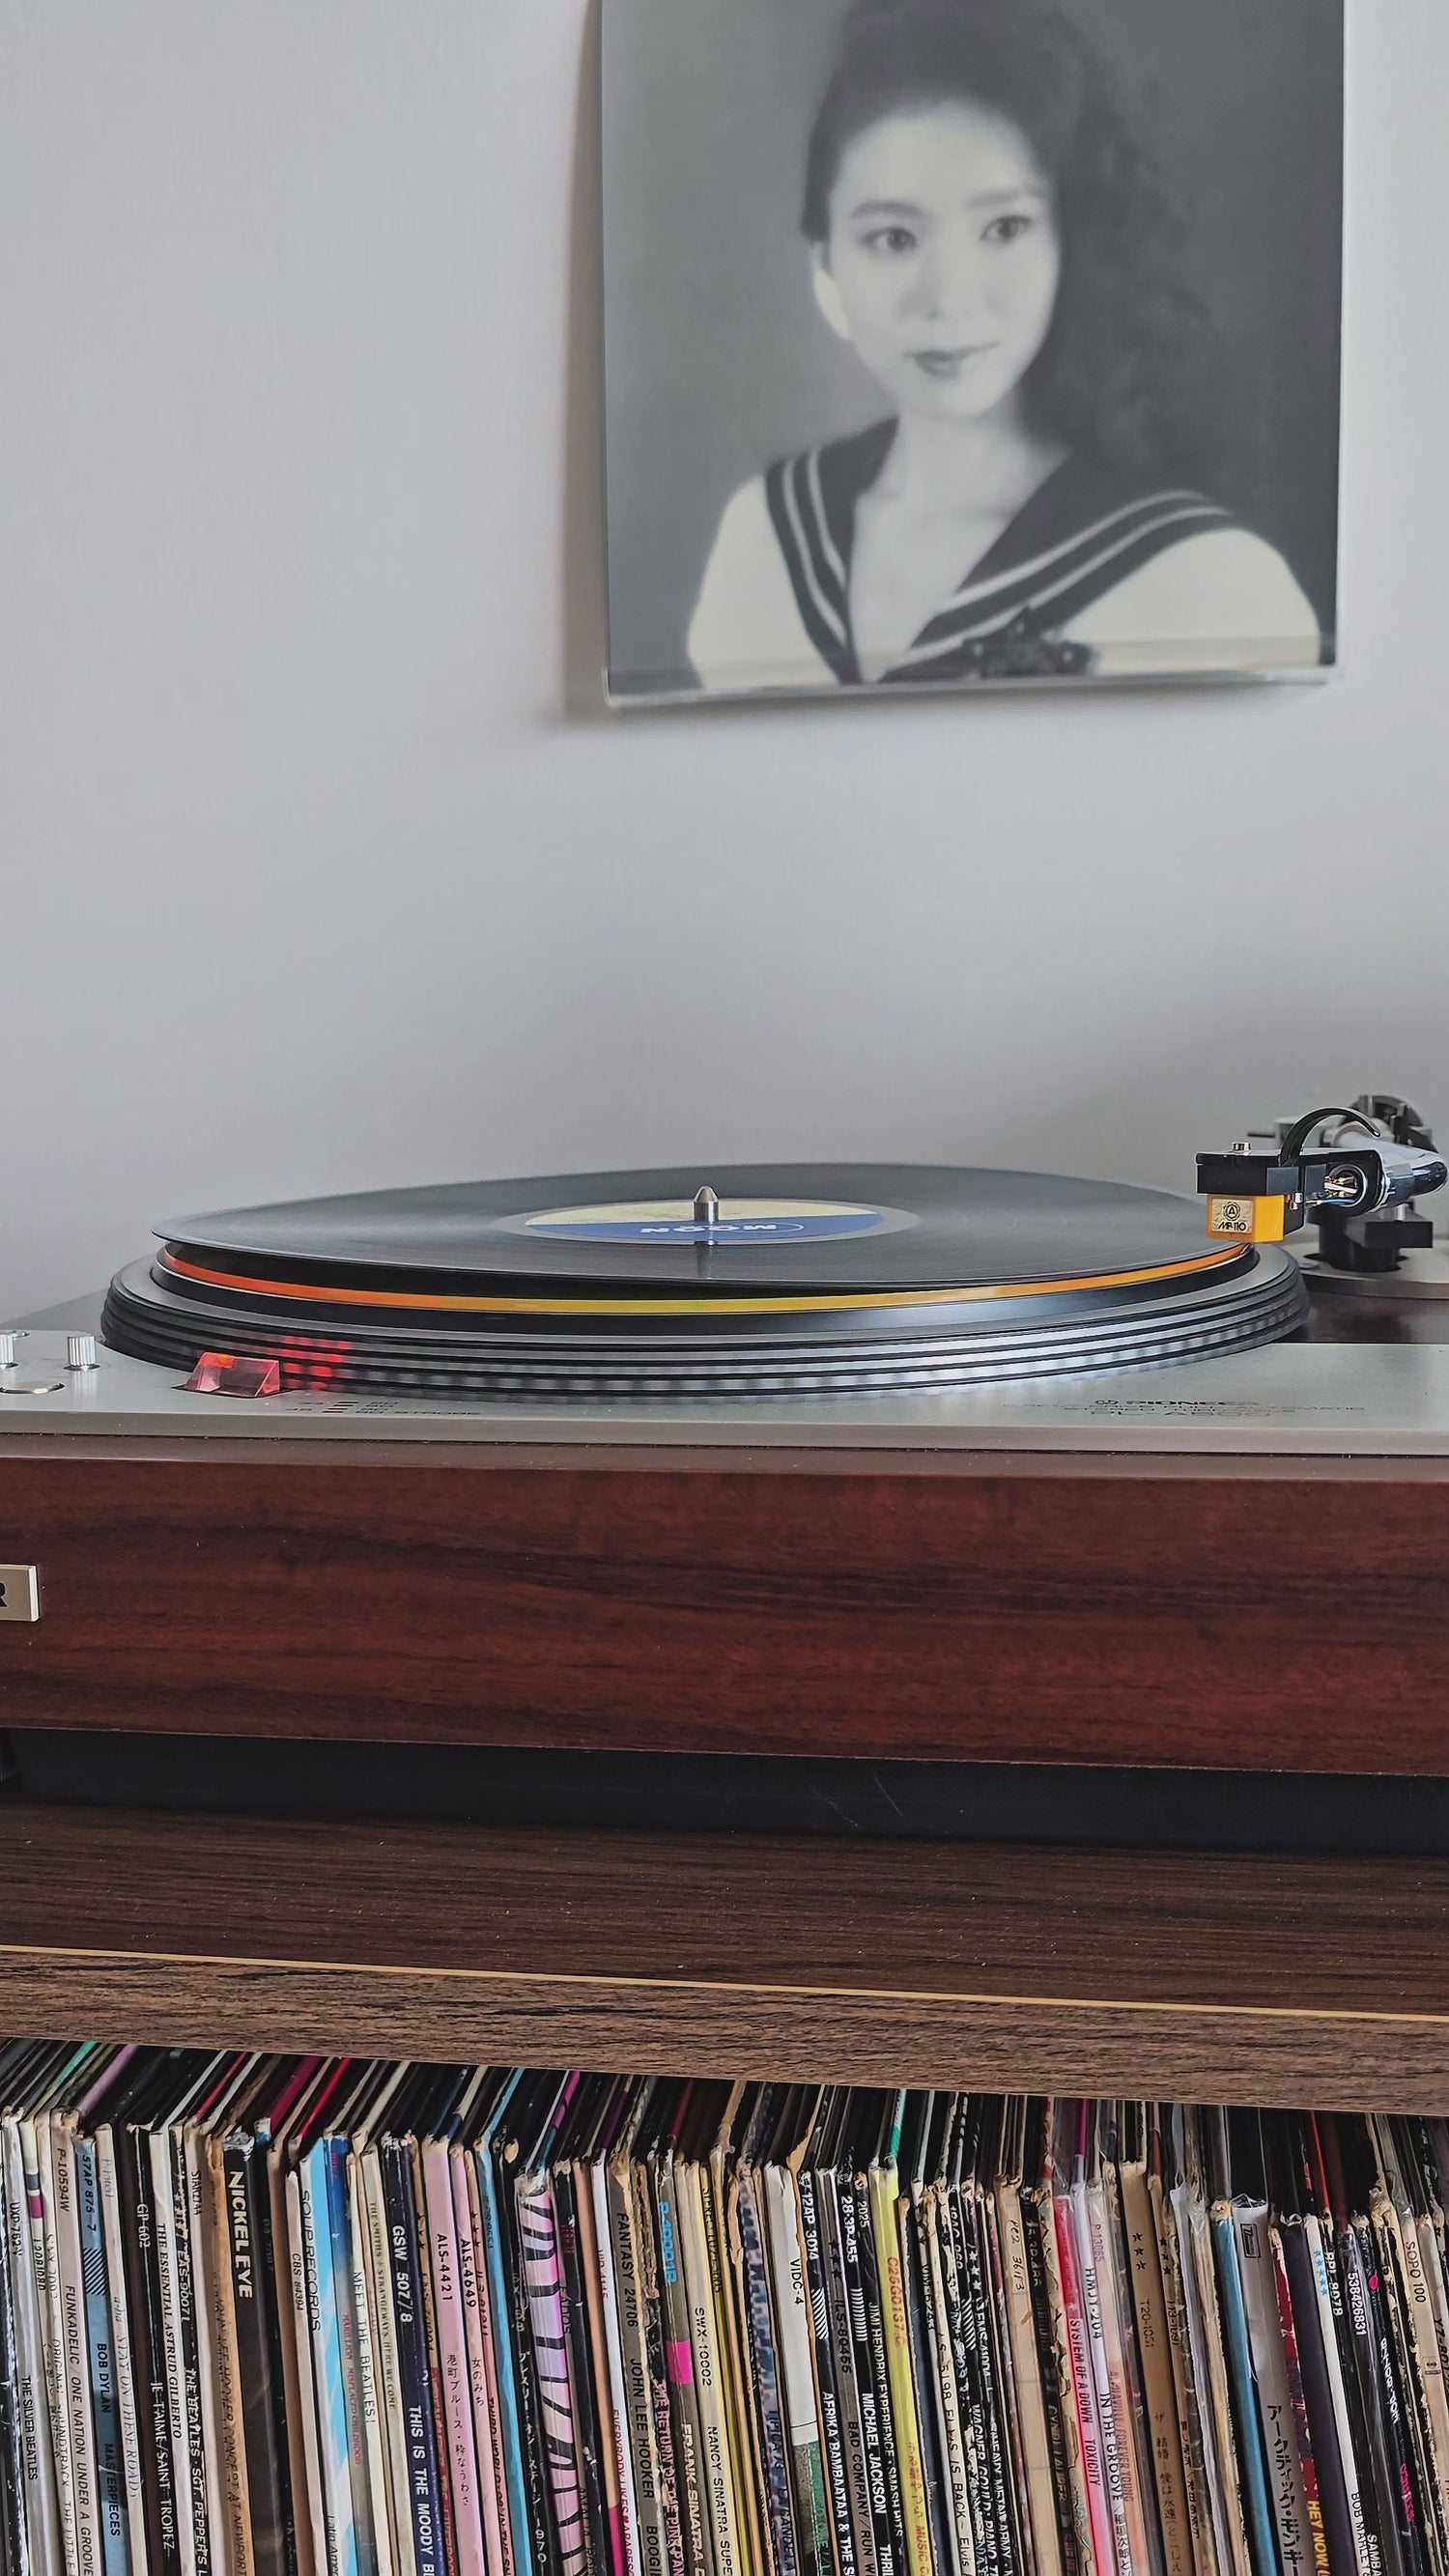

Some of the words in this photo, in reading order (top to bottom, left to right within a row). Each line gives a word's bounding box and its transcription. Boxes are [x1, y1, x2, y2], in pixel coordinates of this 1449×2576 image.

[57, 2148, 70, 2212] P-10594W
[157, 2223, 167, 2248] THE
[302, 2191, 314, 2240] SOUP
[857, 2201, 869, 2228] 2025
[372, 2222, 382, 2256] SMITHS
[392, 2225, 408, 2260] GSW
[805, 2230, 818, 2260] 3014
[159, 2252, 172, 2319] ESSENTIAL
[292, 2253, 301, 2275] CBS
[437, 2233, 453, 2301] ALS-4421
[461, 2239, 476, 2307] ALS-4649
[616, 2213, 634, 2280] FANTASY
[625, 2288, 639, 2327] 24706
[789, 2258, 805, 2305] VIDC-4
[1406, 2241, 1421, 2278] SOPO
[1414, 2282, 1427, 2303] 100
[304, 2246, 321, 2331] RECORDS
[1347, 2272, 1366, 2335] 538426831
[66, 2285, 80, 2364] FUNKADELIC
[868, 2302, 879, 2326] JIMI
[98, 2343, 108, 2368] BOB
[164, 2322, 177, 2372] ASTRUD
[695, 2307, 712, 2387] SWX-10002
[872, 2328, 886, 2381] HENDRIX
[1068, 2319, 1086, 2363] SYSTEM
[21, 2375, 32, 2396] THE
[71, 2377, 83, 2402] ONE
[99, 2373, 111, 2412] DYLAN
[185, 2368, 196, 2393] THE
[630, 2359, 644, 2397] JOHN
[1076, 2366, 1087, 2380] OF
[22, 2399, 34, 2432] SILVER
[169, 2377, 182, 2439] GILBERTO
[409, 2405, 425, 2437] THIS
[635, 2405, 648, 2430] LEE
[821, 2392, 835, 2437] AFRIKA
[861, 2392, 879, 2449] MICHAEL
[878, 2384, 894, 2456] EXPERIENCE
[1080, 2392, 1094, 2423] DOWN
[1102, 2415, 1115, 2438] THE
[72, 2410, 85, 2454] NATION
[412, 2446, 426, 2458] IS
[657, 2411, 671, 2461] RETURN
[707, 2427, 722, 2471] NANCY
[848, 2421, 861, 2447] BAD
[26, 2437, 38, 2479] BEATLES
[639, 2438, 655, 2499] HOOKER
[828, 2442, 845, 2517] BAMBAATAA
[1084, 2439, 1100, 2486] TOXICITY
[1105, 2444, 1122, 2501] GROOVE
[77, 2462, 89, 2505] UNDER
[103, 2443, 120, 2536] MASTERPIECES
[414, 2469, 429, 2495] THE
[868, 2454, 884, 2513] JACKSON
[80, 2511, 90, 2520] A
[160, 2499, 175, 2550] TROPEZ
[688, 2490, 704, 2561] SINATRA
[714, 2477, 728, 2534] SINATRA
[952, 2483, 966, 2519] BACK
[959, 2537, 972, 2566] Elvis
[1307, 2500, 1322, 2528] HEY
[1351, 2492, 1363, 2518] BOB
[327, 2515, 336, 2542] Latin
[417, 2504, 434, 2556] MOODY
[838, 2523, 849, 2532] &
[839, 2536, 852, 2562] THE
[915, 2525, 928, 2562] MUSIC
[1312, 2532, 1327, 2566] NOW
[80, 2528, 94, 2576] GROOVE
